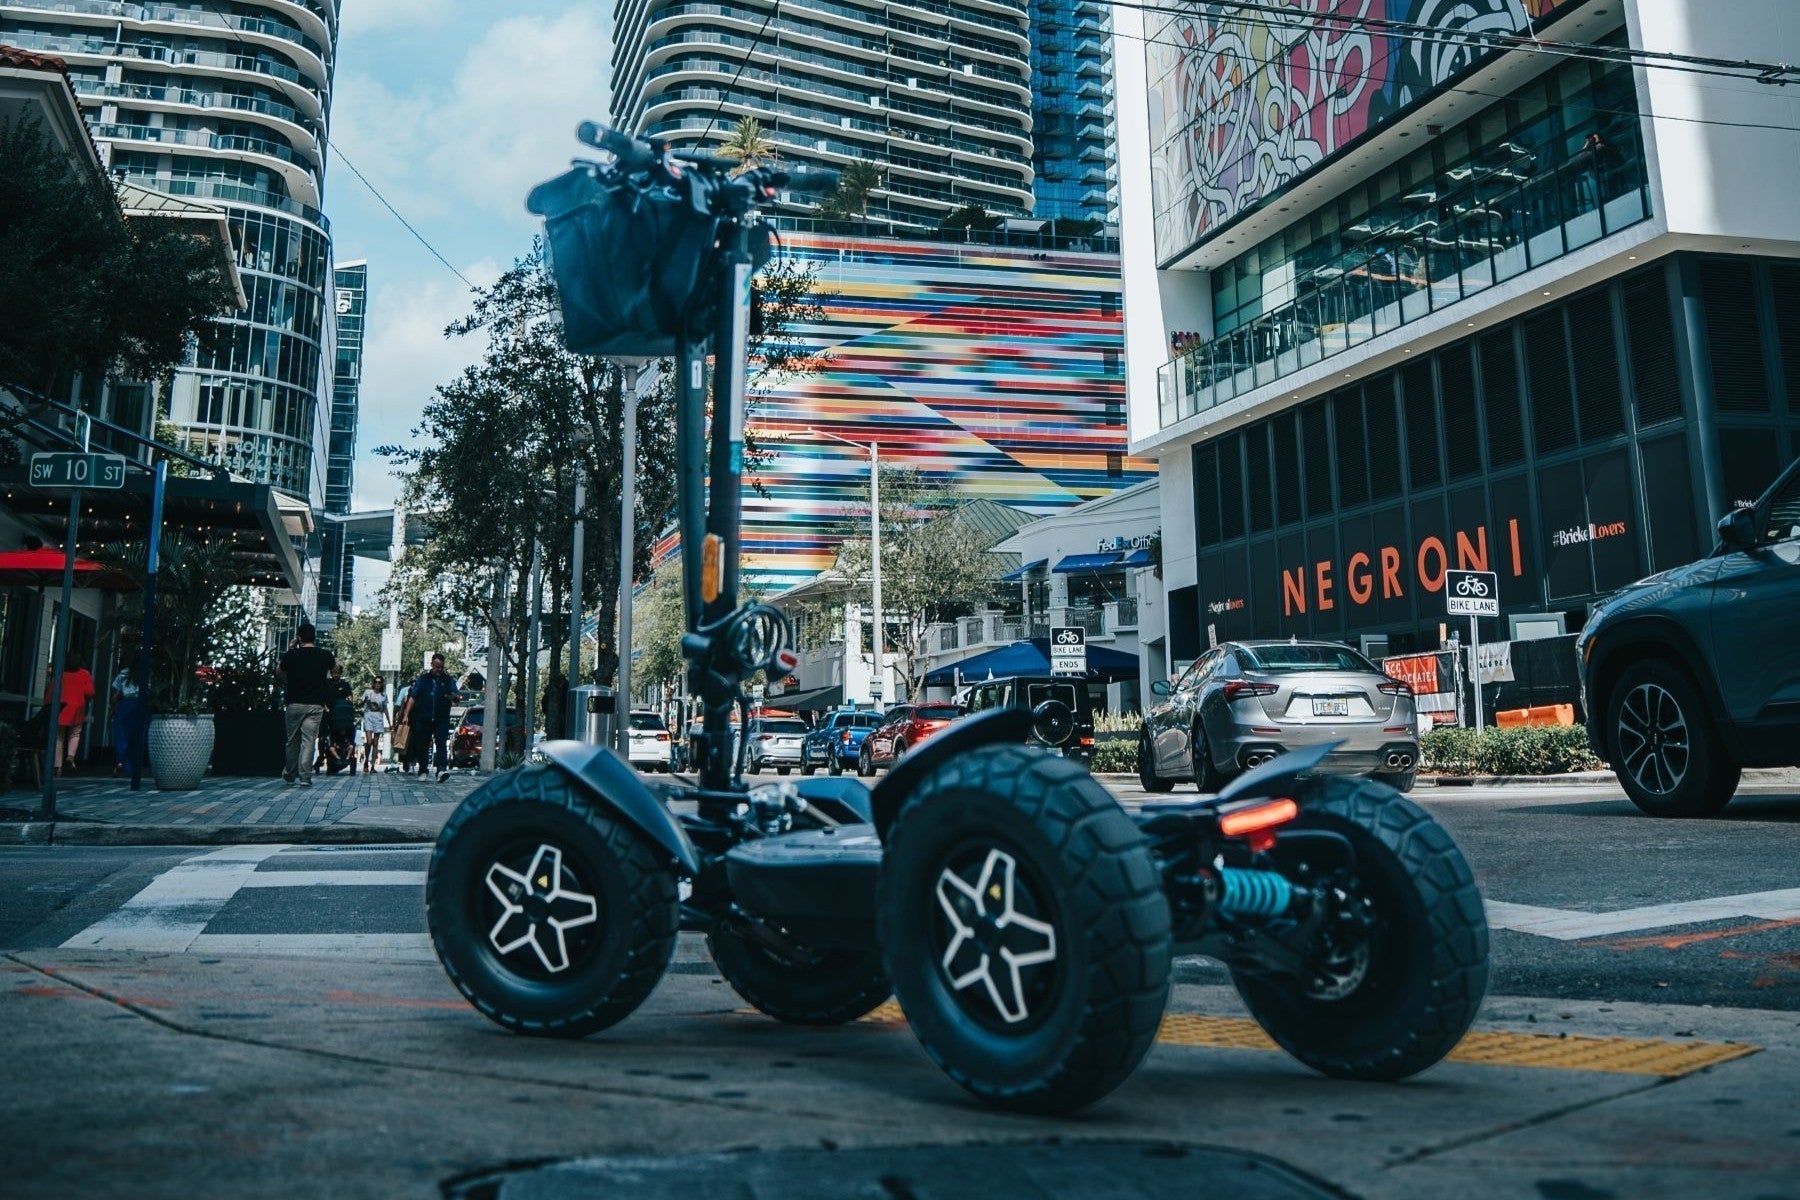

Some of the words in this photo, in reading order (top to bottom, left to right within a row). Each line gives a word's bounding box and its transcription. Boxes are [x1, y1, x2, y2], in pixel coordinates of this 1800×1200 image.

[33, 464, 54, 479] SW
[66, 459, 88, 481] 10
[104, 466, 121, 480] ST
[1282, 518, 1523, 617] NEGRONI
[1451, 600, 1470, 611] BIKE
[1473, 601, 1496, 612] LANE
[1053, 646, 1067, 654] BIKE
[1068, 646, 1084, 654] LANE
